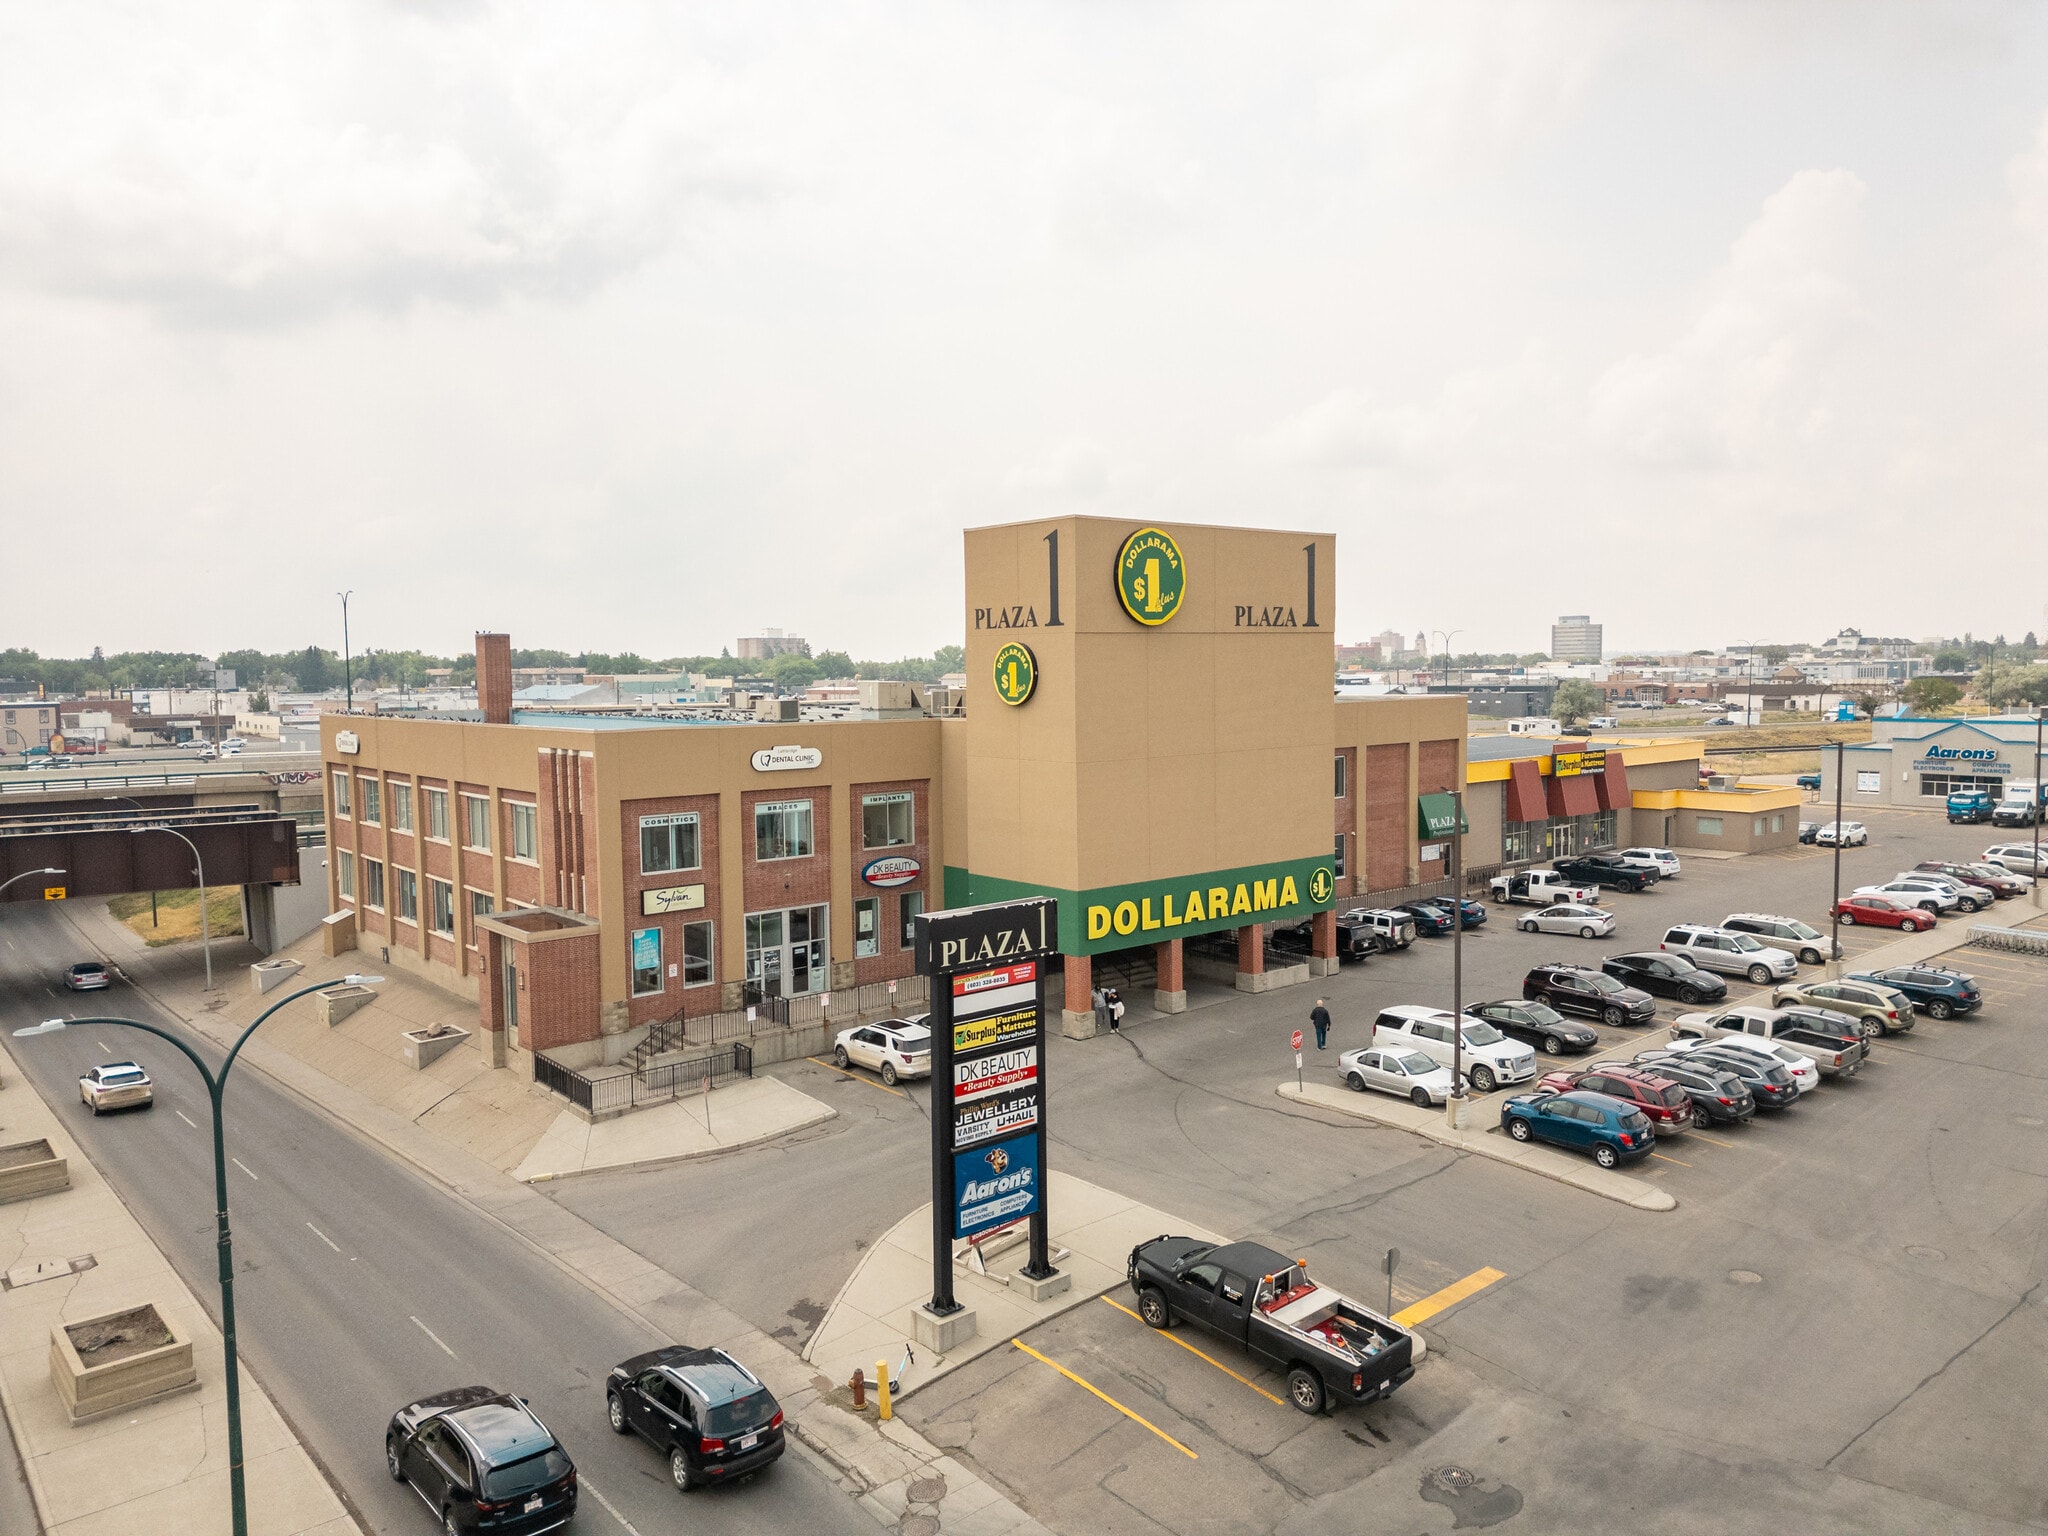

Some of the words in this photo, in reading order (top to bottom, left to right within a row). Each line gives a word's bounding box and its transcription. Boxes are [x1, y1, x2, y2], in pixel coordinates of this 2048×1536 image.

[1126, 537, 1178, 569] DOLLARAMA
[975, 605, 1038, 629] PLAZA
[1043, 529, 1064, 626] 1
[1235, 605, 1297, 627] PLAZA
[1302, 542, 1319, 627] 1
[997, 648, 1028, 669] DOLLARAMA
[772, 755, 793, 763] DENTAL
[795, 754, 814, 762] CLINIC
[1926, 745, 1996, 760] Aaron's
[645, 816, 694, 825] COSMETICS
[873, 864, 884, 874] DK
[885, 861, 912, 872] BEAUTY
[656, 890, 692, 911] Sylvan
[1088, 876, 1299, 940] DOLLARAMA
[940, 928, 1032, 967] PLAZA
[1038, 905, 1048, 950] 1
[996, 1010, 1036, 1024] Furniture
[966, 1026, 996, 1042] Surplus
[997, 1026, 1002, 1034] &
[1002, 1019, 1036, 1032] Mattress
[997, 1028, 1036, 1042] Warehouse
[960, 1062, 979, 1082] DK
[981, 1049, 1031, 1077] BEAUTY
[955, 1095, 1036, 1126] JEWELLERY
[957, 1121, 990, 1137] VARSITY
[959, 1167, 1032, 1207] Aaron's
[1000, 1194, 1028, 1206] COMPUTERS
[1000, 1200, 1028, 1213] APPLIANCES
[963, 1206, 988, 1219] FURNITURE
[963, 1211, 995, 1225] ELECTRONICS
